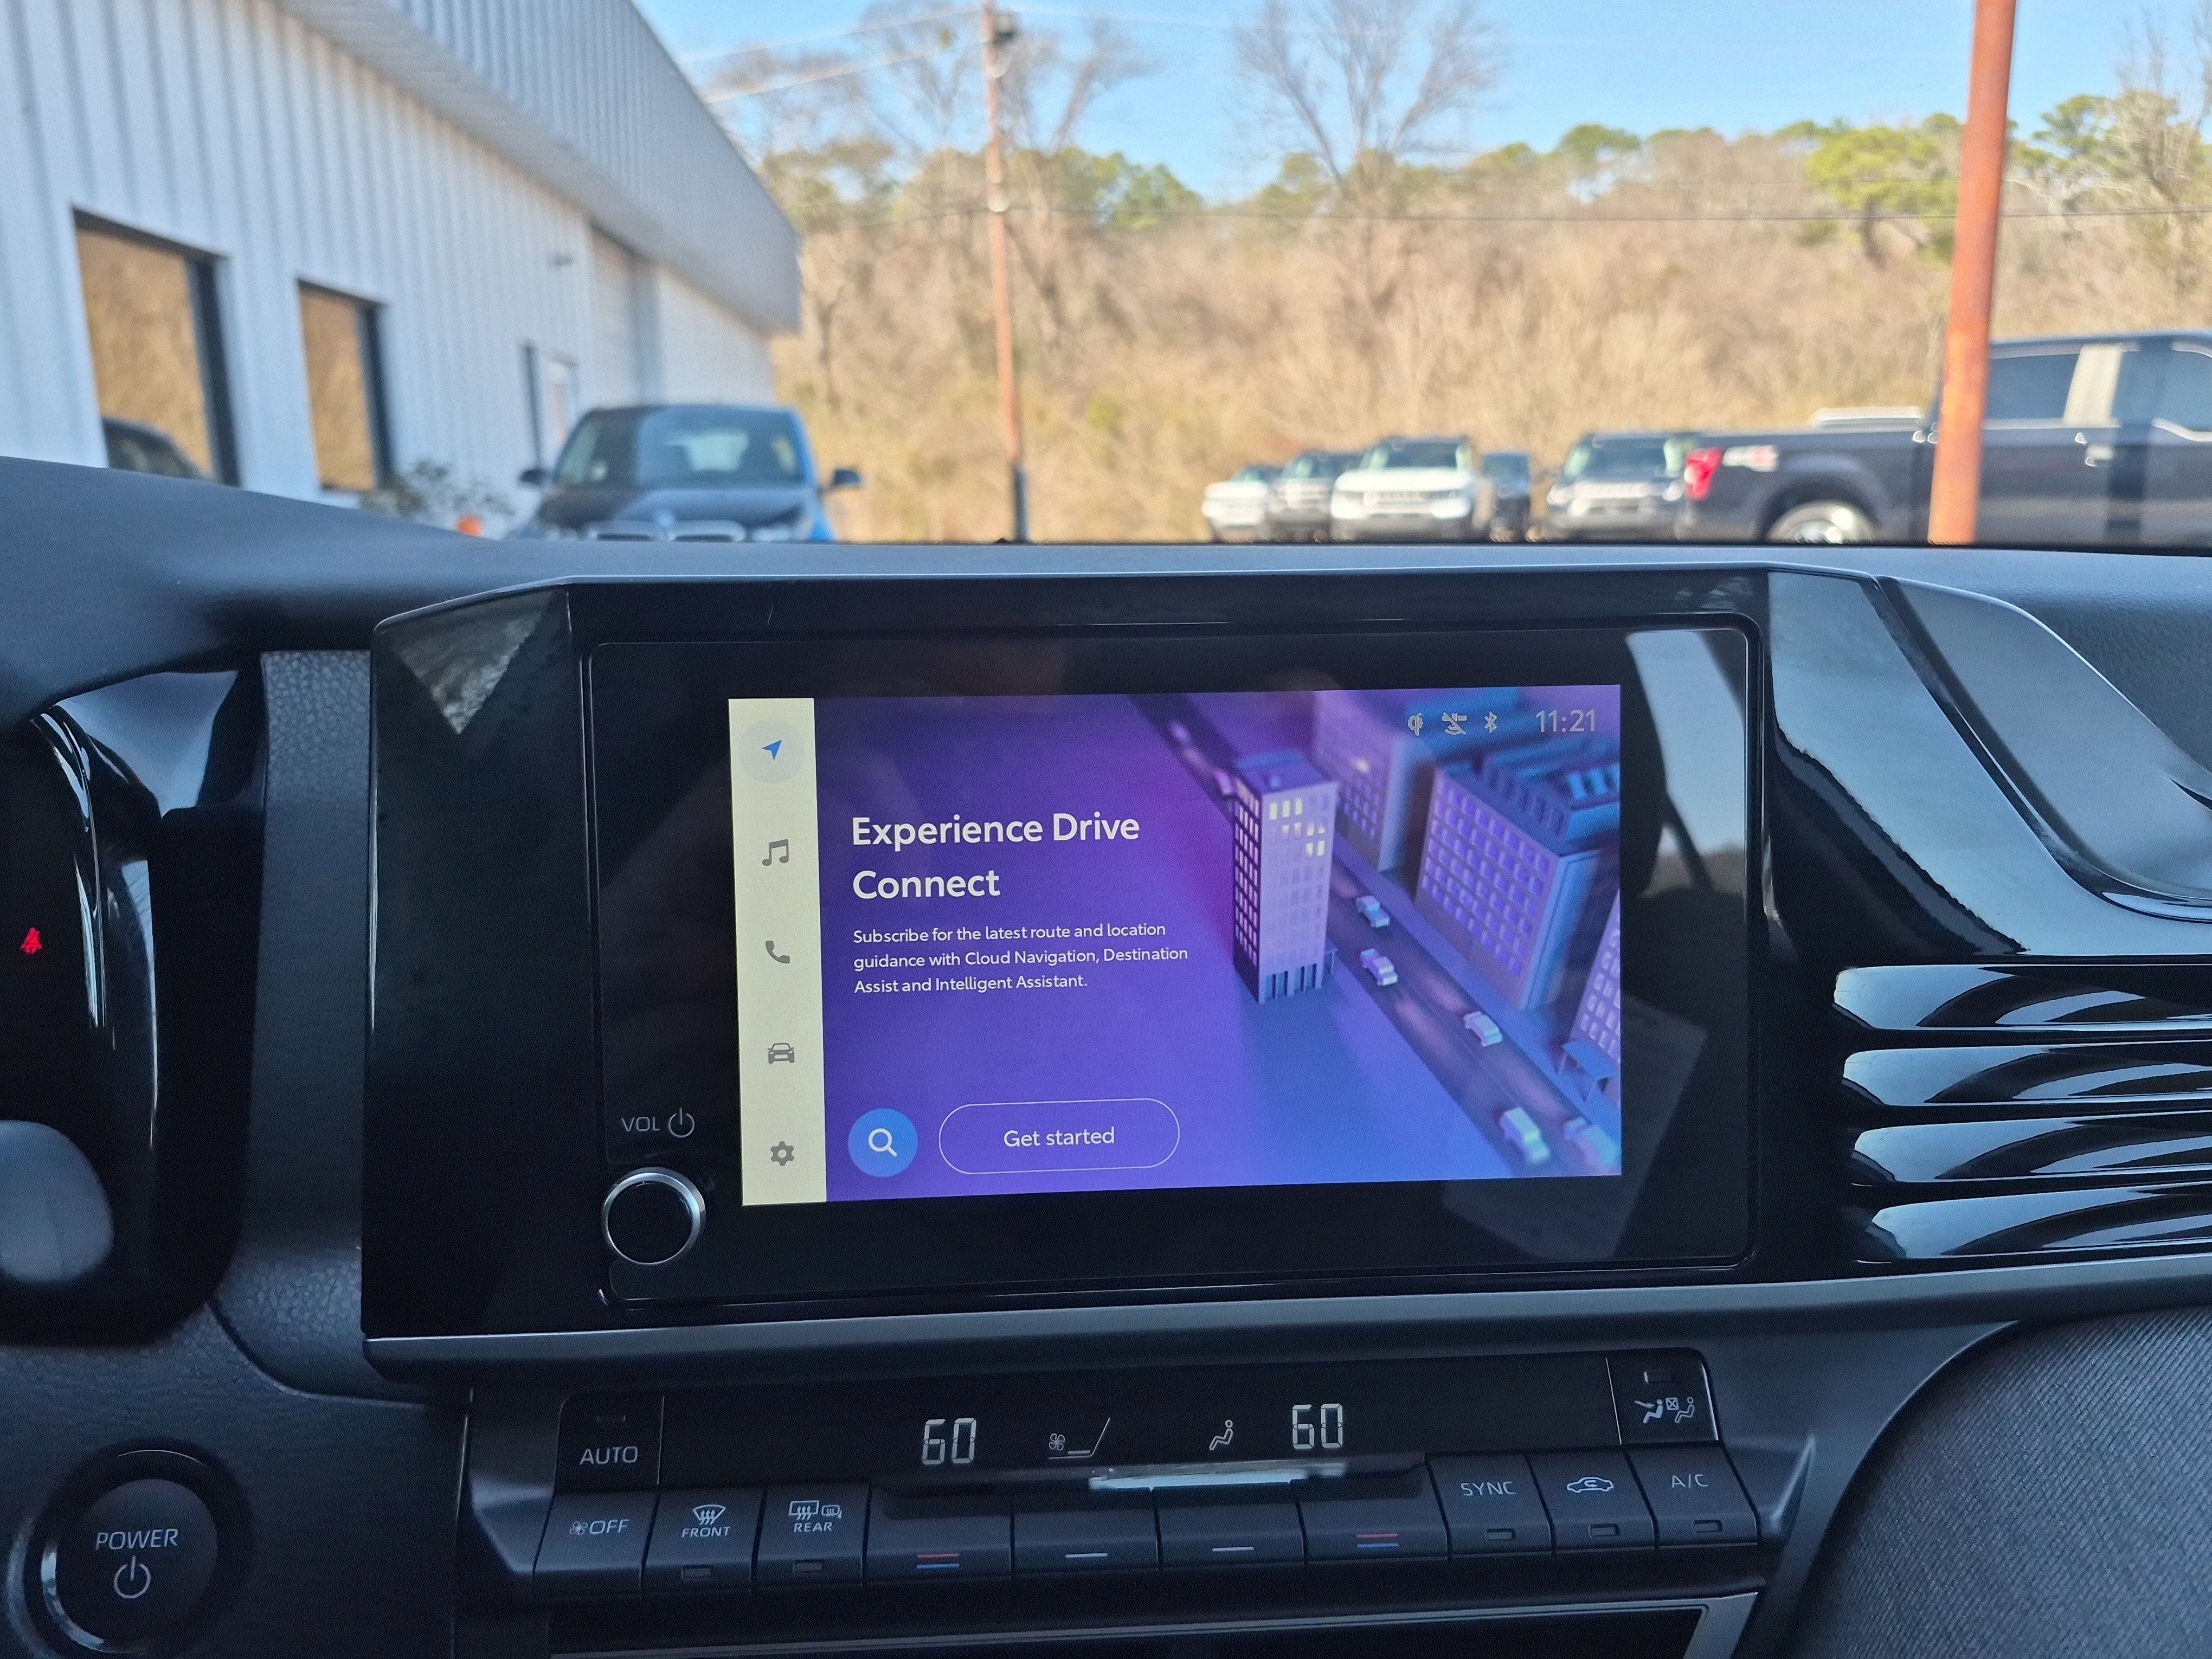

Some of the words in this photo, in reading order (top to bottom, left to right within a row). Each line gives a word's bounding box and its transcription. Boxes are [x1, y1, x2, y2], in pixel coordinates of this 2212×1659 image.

[1535, 708, 1596, 732] 11:21
[852, 814, 1043, 852] Experience
[1053, 811, 1140, 841] Drive
[853, 870, 1001, 899] Connect
[853, 928, 929, 943] Subscribe
[931, 927, 953, 941] for
[956, 927, 981, 941] the
[985, 926, 1028, 940] latest
[1030, 926, 1071, 938] route
[1073, 923, 1103, 938] and
[1107, 923, 1166, 937] location
[853, 954, 925, 972] guidance
[929, 952, 961, 966] with
[964, 950, 1011, 966] Cloud
[1014, 949, 1099, 967] Navigation,
[1103, 947, 1188, 962] Destination
[854, 980, 899, 993] Assist
[902, 978, 932, 992] and
[936, 976, 1013, 993] Intelligent
[1015, 975, 1088, 988] Assistant.
[621, 1116, 660, 1133] VOL
[1004, 1130, 1040, 1148] Get
[1046, 1126, 1115, 1146] started
[1292, 1403, 1343, 1450] 60
[922, 1417, 977, 1465] 60
[579, 1445, 639, 1465] AUTO
[1460, 1481, 1517, 1497] SYNC
[1671, 1474, 1710, 1489] A/C
[588, 1519, 629, 1535] OFF
[681, 1526, 730, 1538] FRONT
[793, 1521, 832, 1533] REAR
[95, 1528, 179, 1550] POWER
